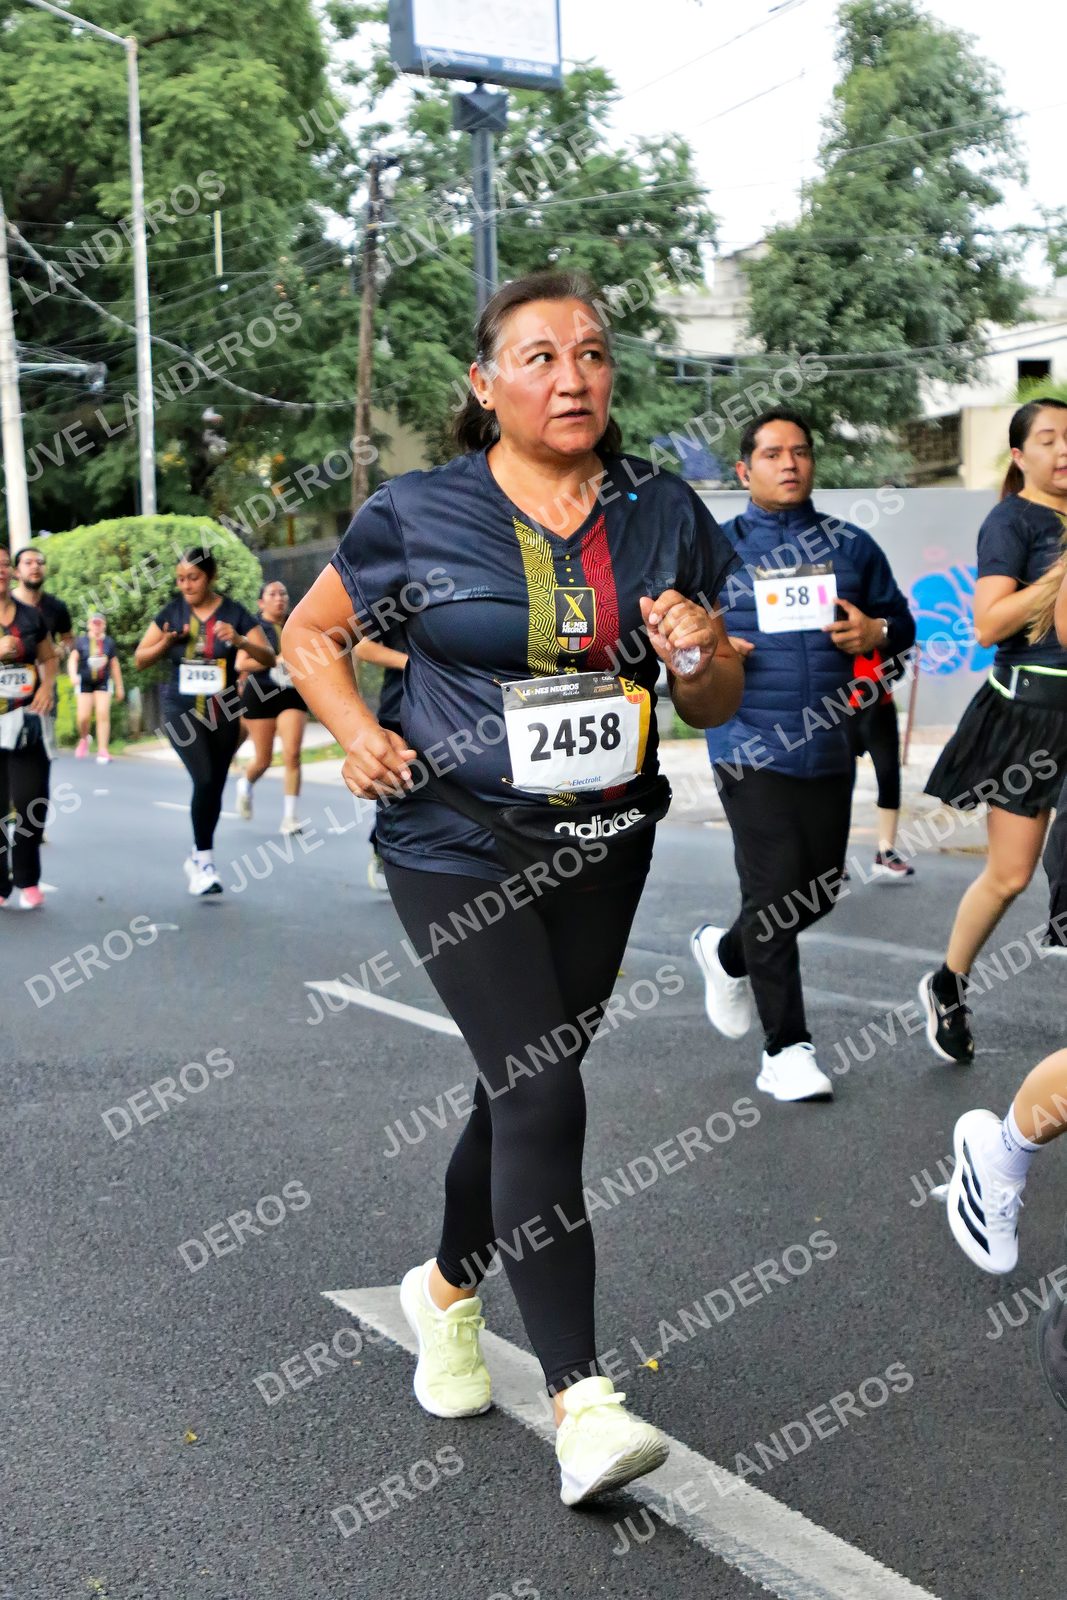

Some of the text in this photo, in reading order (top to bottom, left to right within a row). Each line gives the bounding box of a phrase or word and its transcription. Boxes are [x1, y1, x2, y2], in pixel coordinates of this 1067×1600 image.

[785, 586, 810, 607] 58
[187, 669, 216, 681] 2105
[550, 683, 580, 693] NEGROS
[527, 712, 621, 762] 2458
[554, 808, 646, 839] adidas
